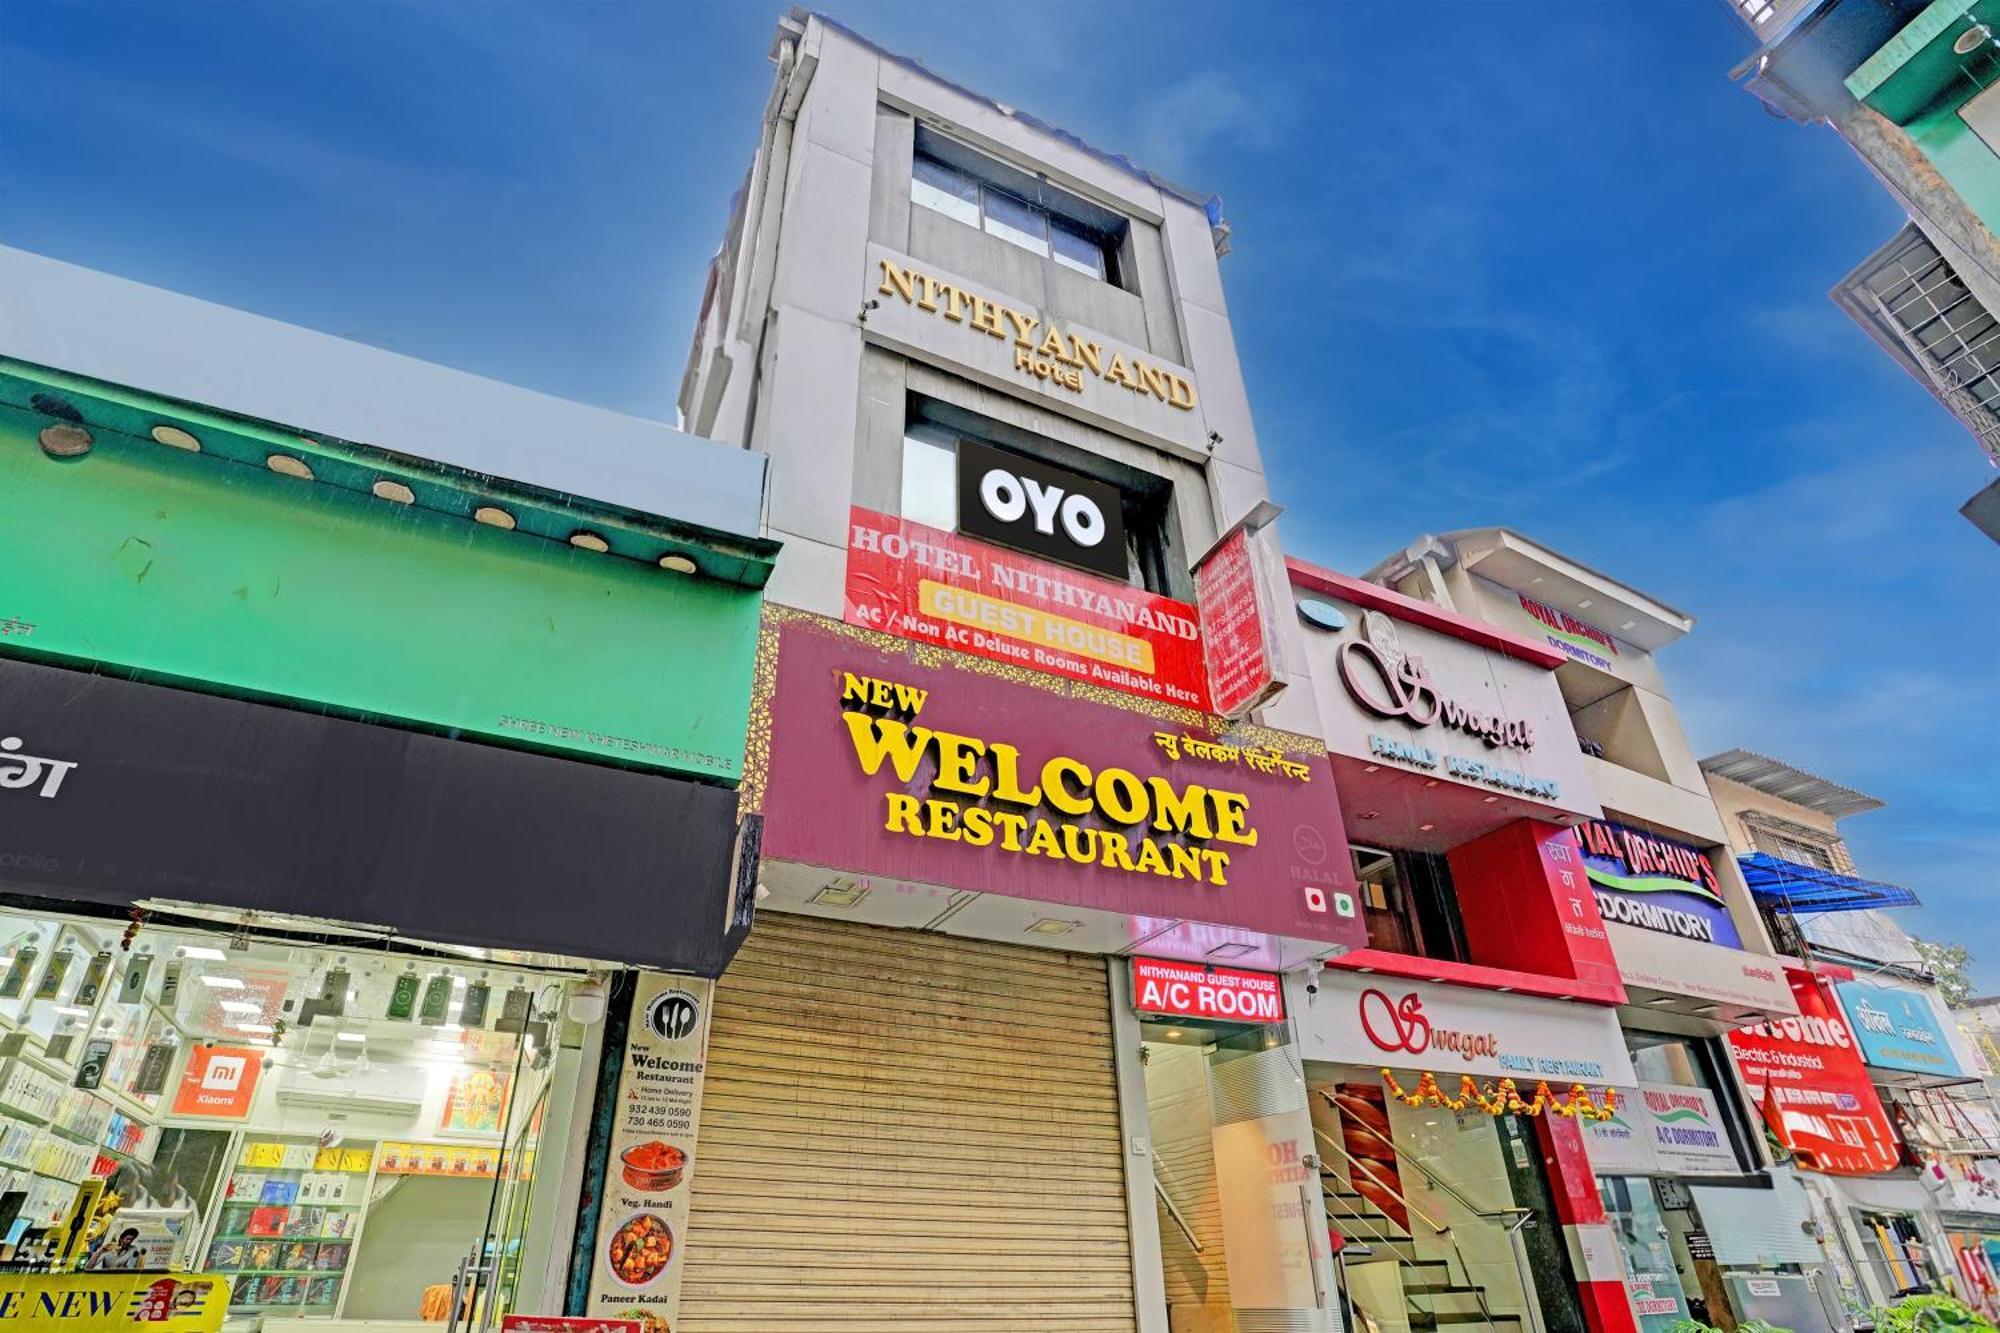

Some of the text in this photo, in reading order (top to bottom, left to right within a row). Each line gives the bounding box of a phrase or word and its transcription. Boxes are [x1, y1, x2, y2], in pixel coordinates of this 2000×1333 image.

[879, 259, 1200, 411] NITHYANAND
[1014, 346, 1086, 393] Hotel
[979, 468, 1106, 548] OYO
[851, 525, 981, 581] HOTEL
[991, 562, 1198, 642] NITHYANAND
[933, 587, 1144, 666] GUEST HOUSE
[856, 604, 881, 623] AC
[903, 615, 940, 638] Non
[945, 624, 970, 646] AC
[974, 632, 1031, 661] Deluxe
[1035, 645, 1089, 677] Rooms
[1092, 664, 1162, 695] Available
[1166, 682, 1201, 705] Here
[1546, 635, 1613, 673] DORMITORY
[843, 672, 929, 714] NEW
[1368, 733, 1440, 772] FAMILY
[842, 711, 1259, 848] WELCOME
[884, 792, 1231, 886] RESTAURANT
[1600, 892, 1713, 942] DORMITORY
[1139, 965, 1276, 992] NITHYANAND GUEST HOUSE
[1141, 980, 1279, 1018] A/C ROOM
[1359, 988, 1498, 1062] Swagat
[630, 1043, 650, 1052] New
[631, 1053, 704, 1073] Welcome
[636, 1071, 694, 1085] Restaurant
[196, 1094, 235, 1106] Xiaomi
[621, 1197, 673, 1209] Veg. Handi
[31, 1291, 125, 1319] NEW
[600, 1293, 668, 1304] Paneer Kadai
